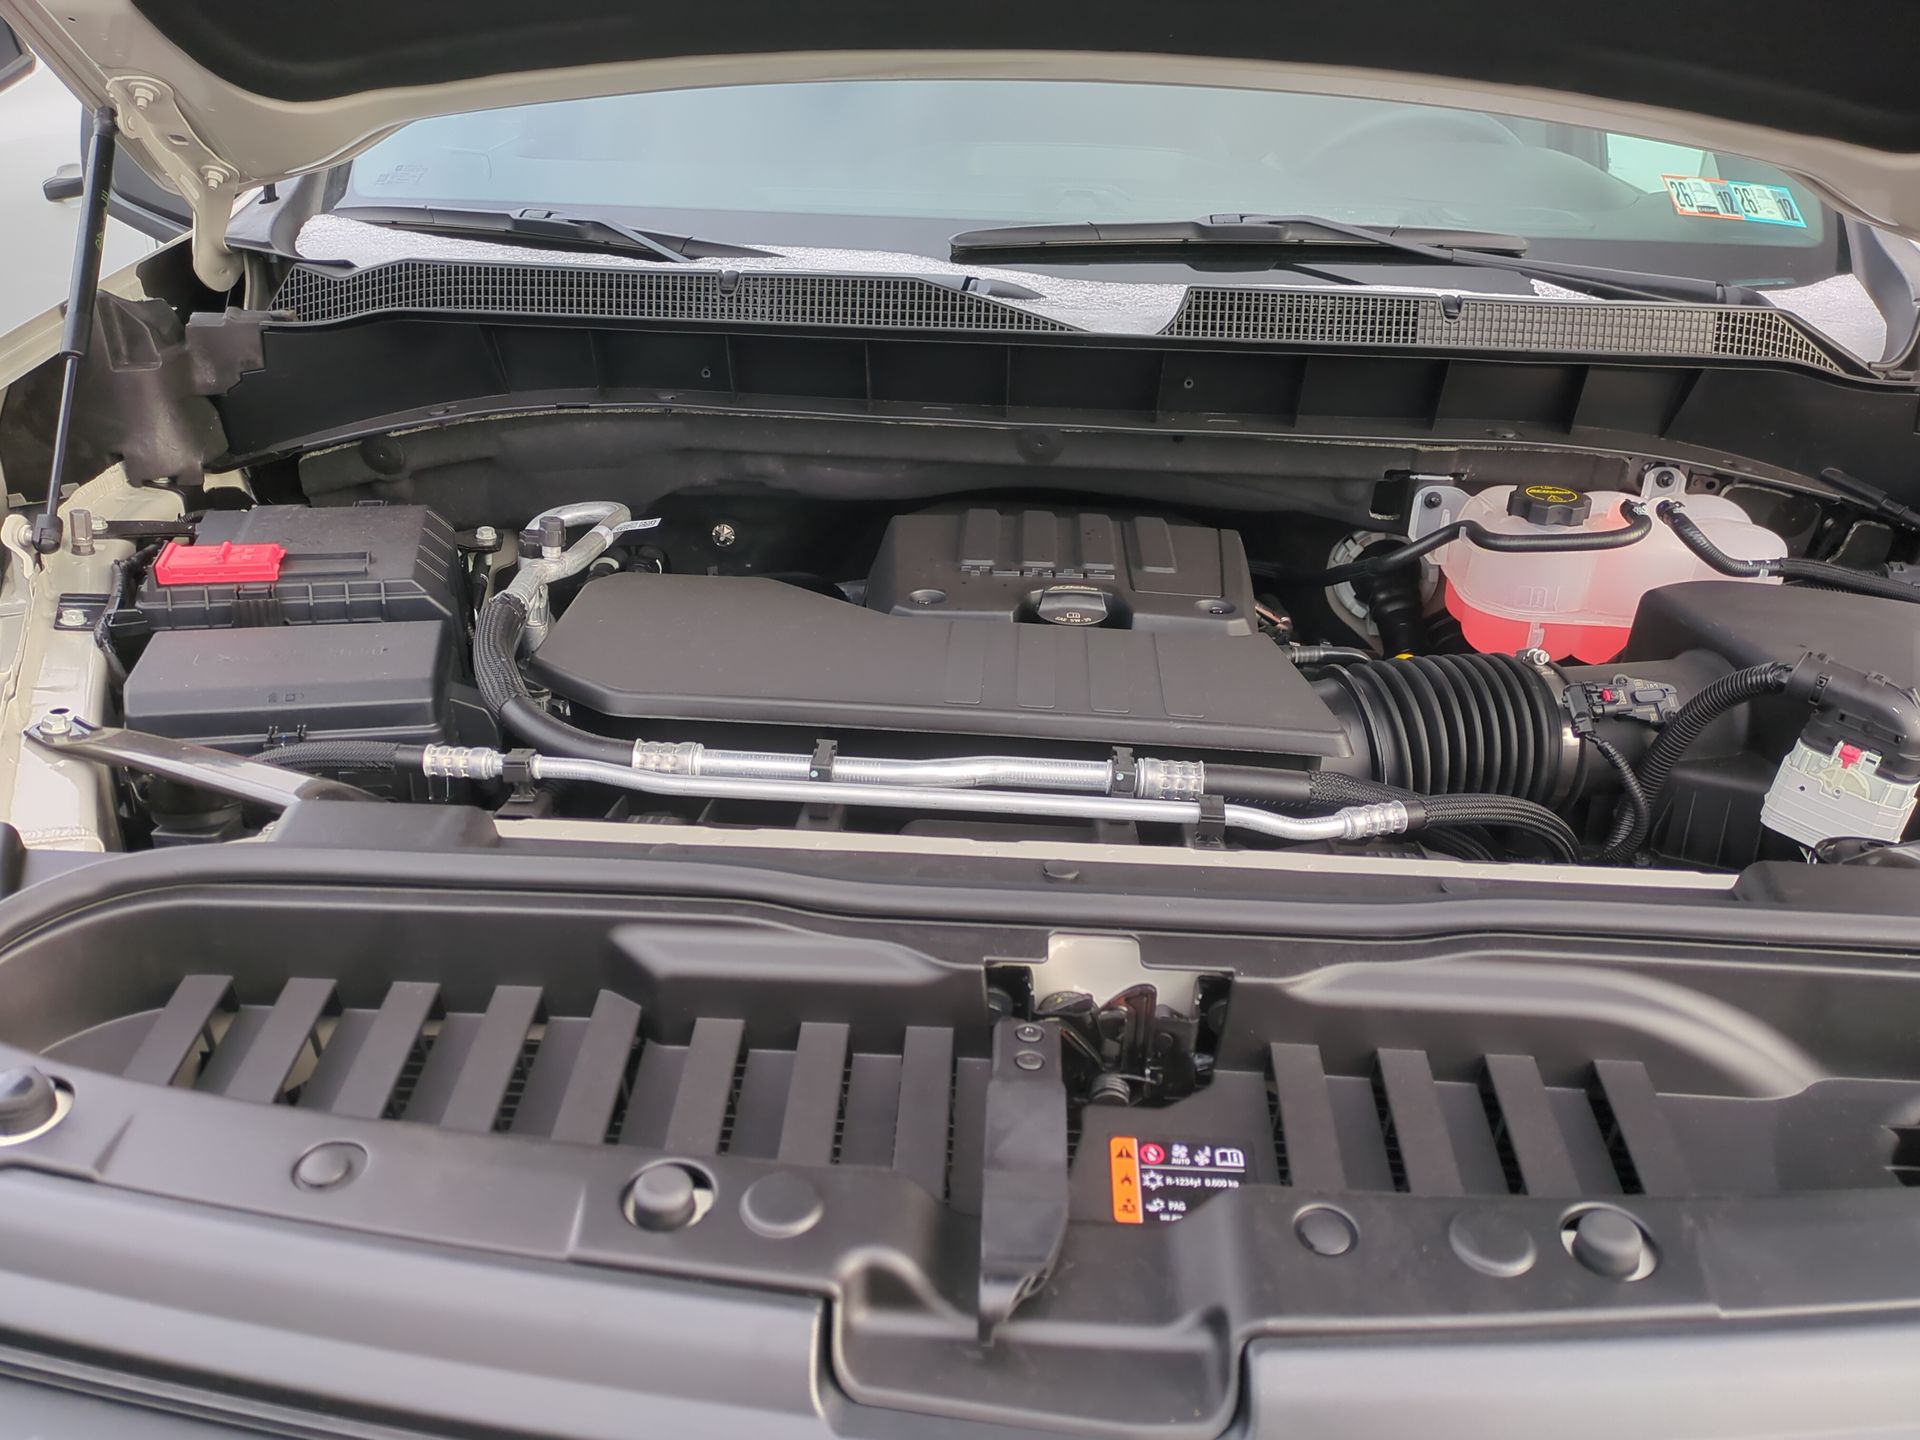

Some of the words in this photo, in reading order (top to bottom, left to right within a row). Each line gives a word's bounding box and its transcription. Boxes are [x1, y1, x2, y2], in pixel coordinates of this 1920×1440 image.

[1670, 181, 1694, 207] 26
[1717, 191, 1739, 214] 12
[1734, 187, 1758, 214] 26
[1777, 198, 1800, 221] 12
[1165, 1177, 1202, 1188] R-1234yf
[1168, 1201, 1187, 1211] PAG
